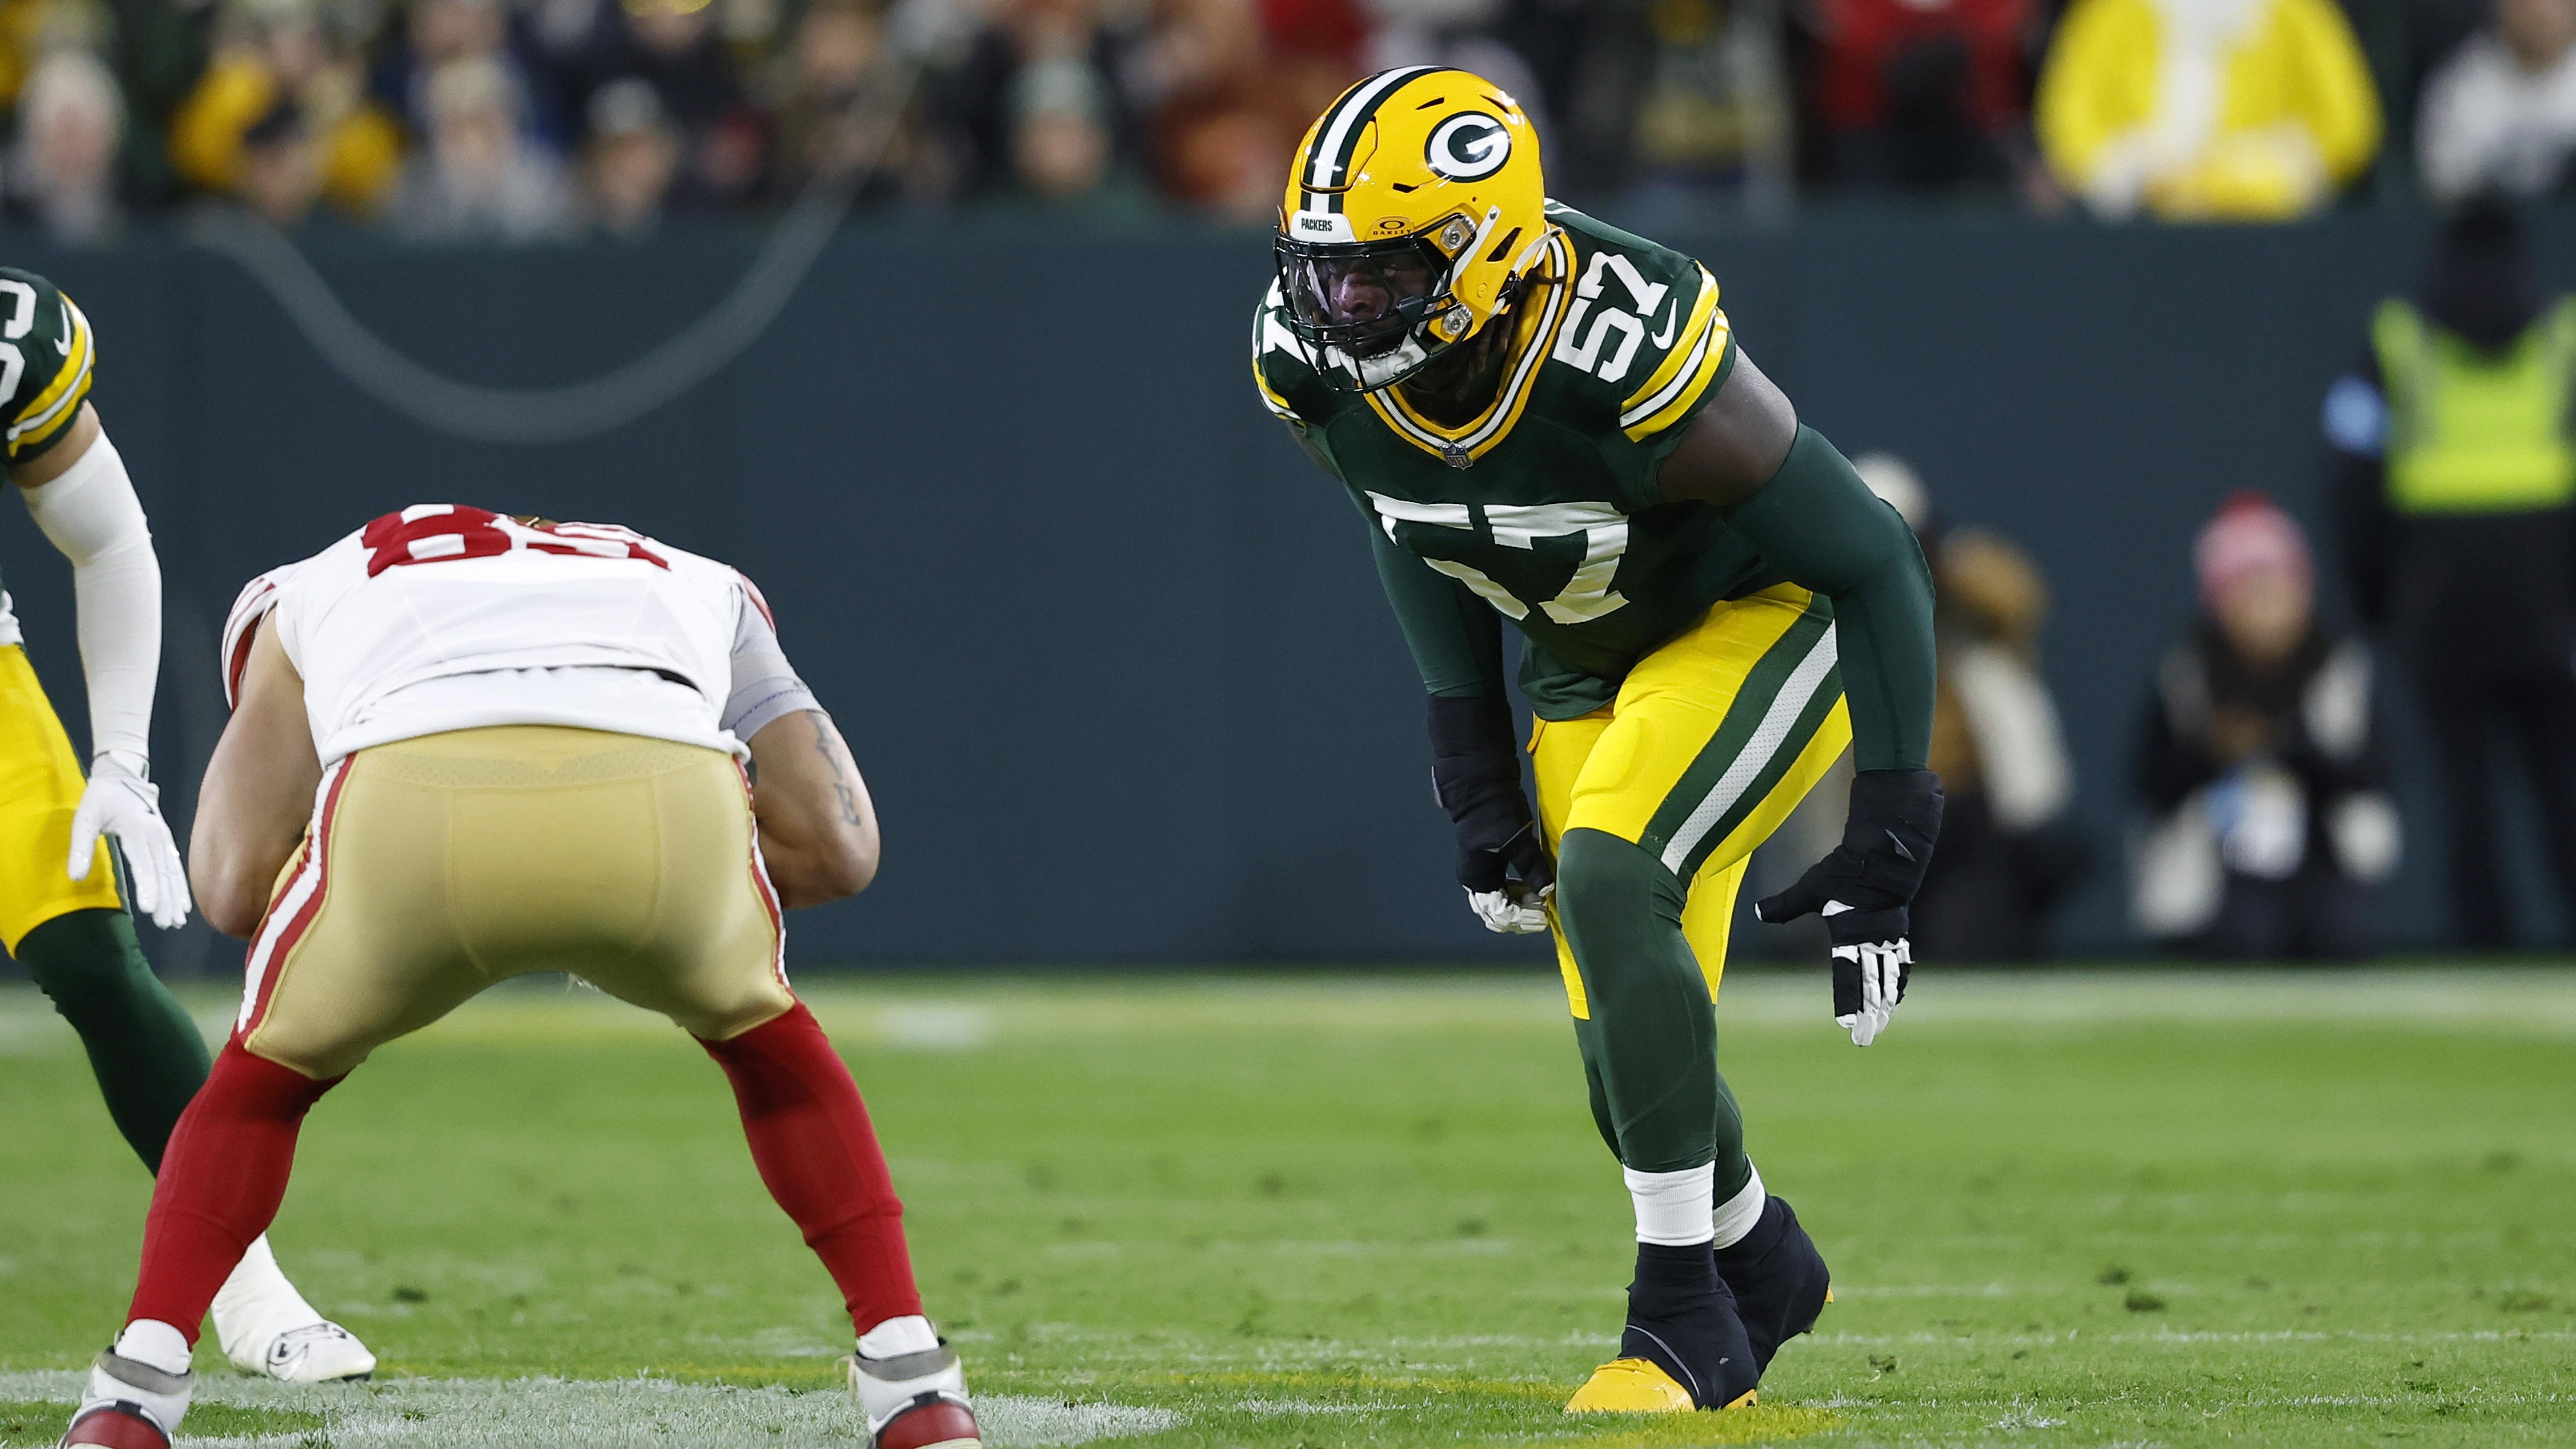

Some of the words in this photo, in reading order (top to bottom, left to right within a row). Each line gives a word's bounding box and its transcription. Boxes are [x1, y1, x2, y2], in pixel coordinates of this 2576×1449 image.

[1301, 218, 1332, 231] PACKERS
[1552, 251, 1669, 383] 57
[1364, 490, 1630, 625] 57
